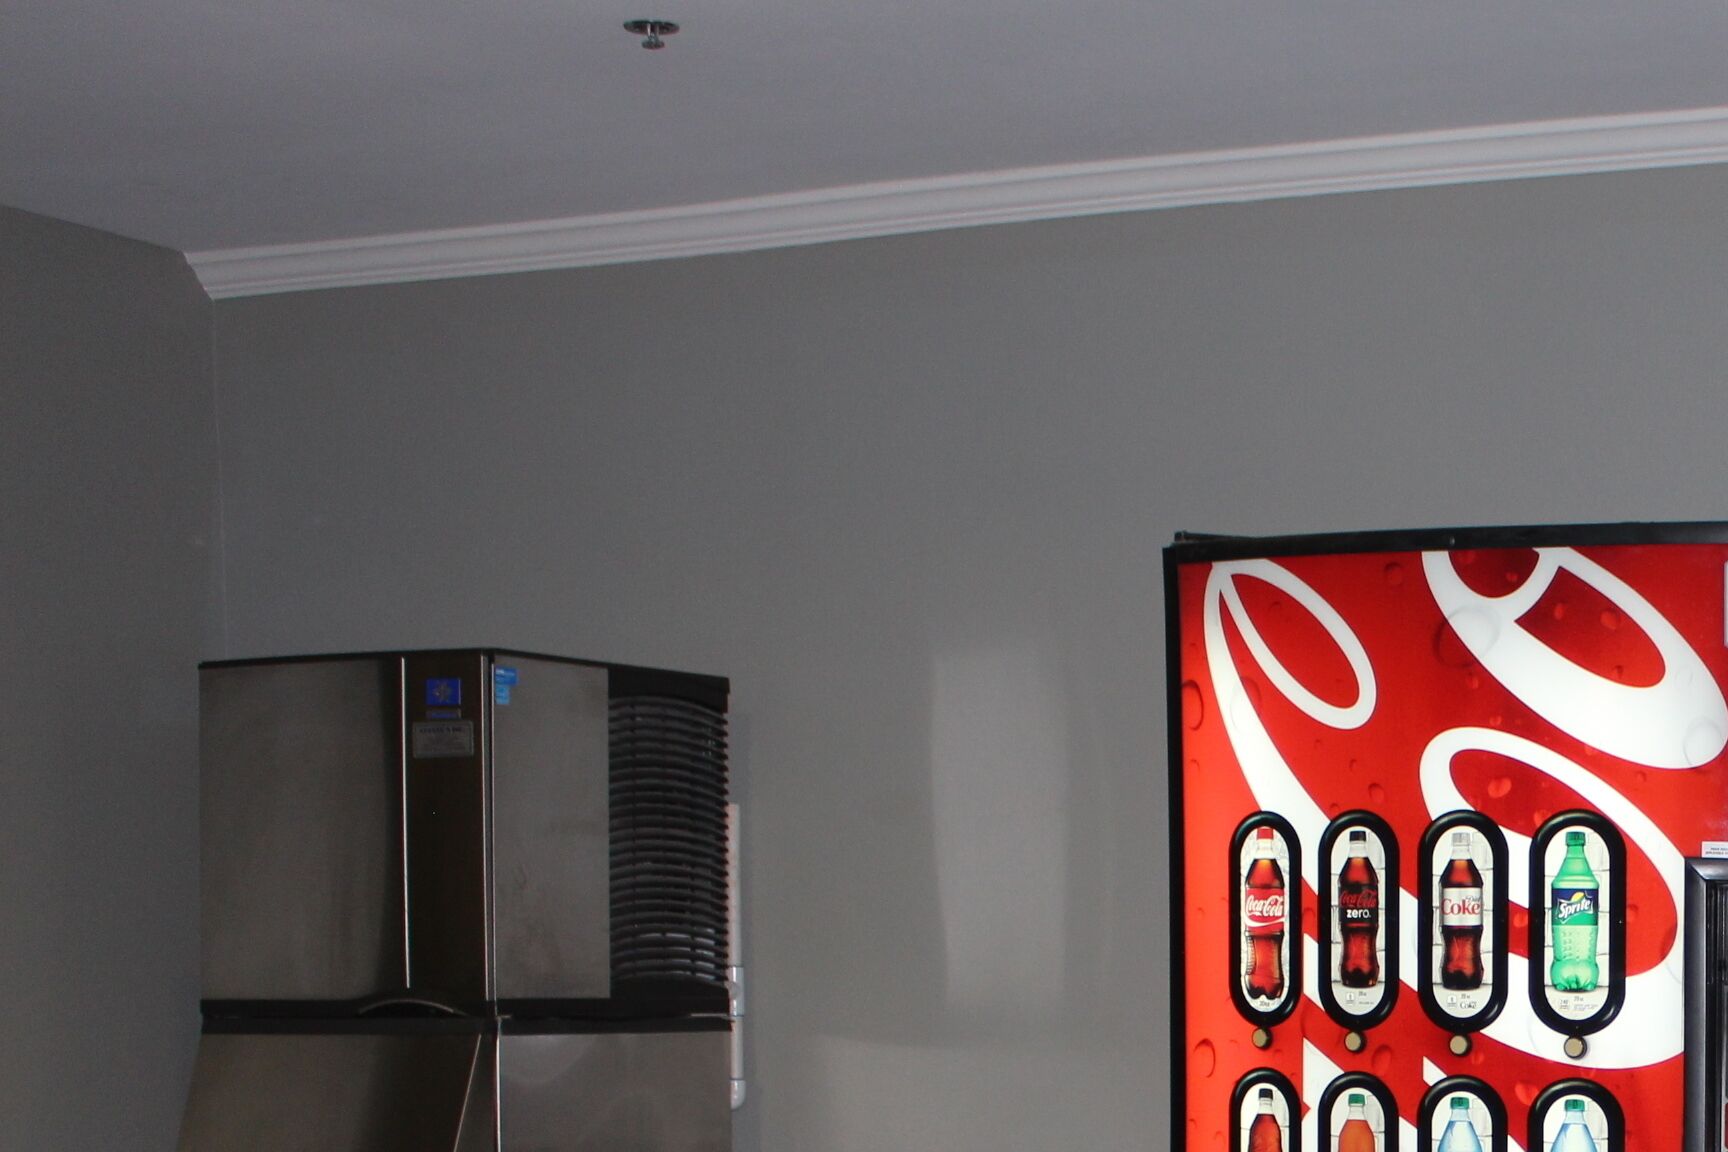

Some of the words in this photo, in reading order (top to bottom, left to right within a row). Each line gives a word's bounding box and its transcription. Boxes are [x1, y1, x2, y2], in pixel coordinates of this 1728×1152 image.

[1245, 894, 1284, 917] Coca-Cola
[1340, 889, 1377, 909] Coca-Cola
[1440, 898, 1481, 916] Coke
[1558, 899, 1592, 919] Sprite
